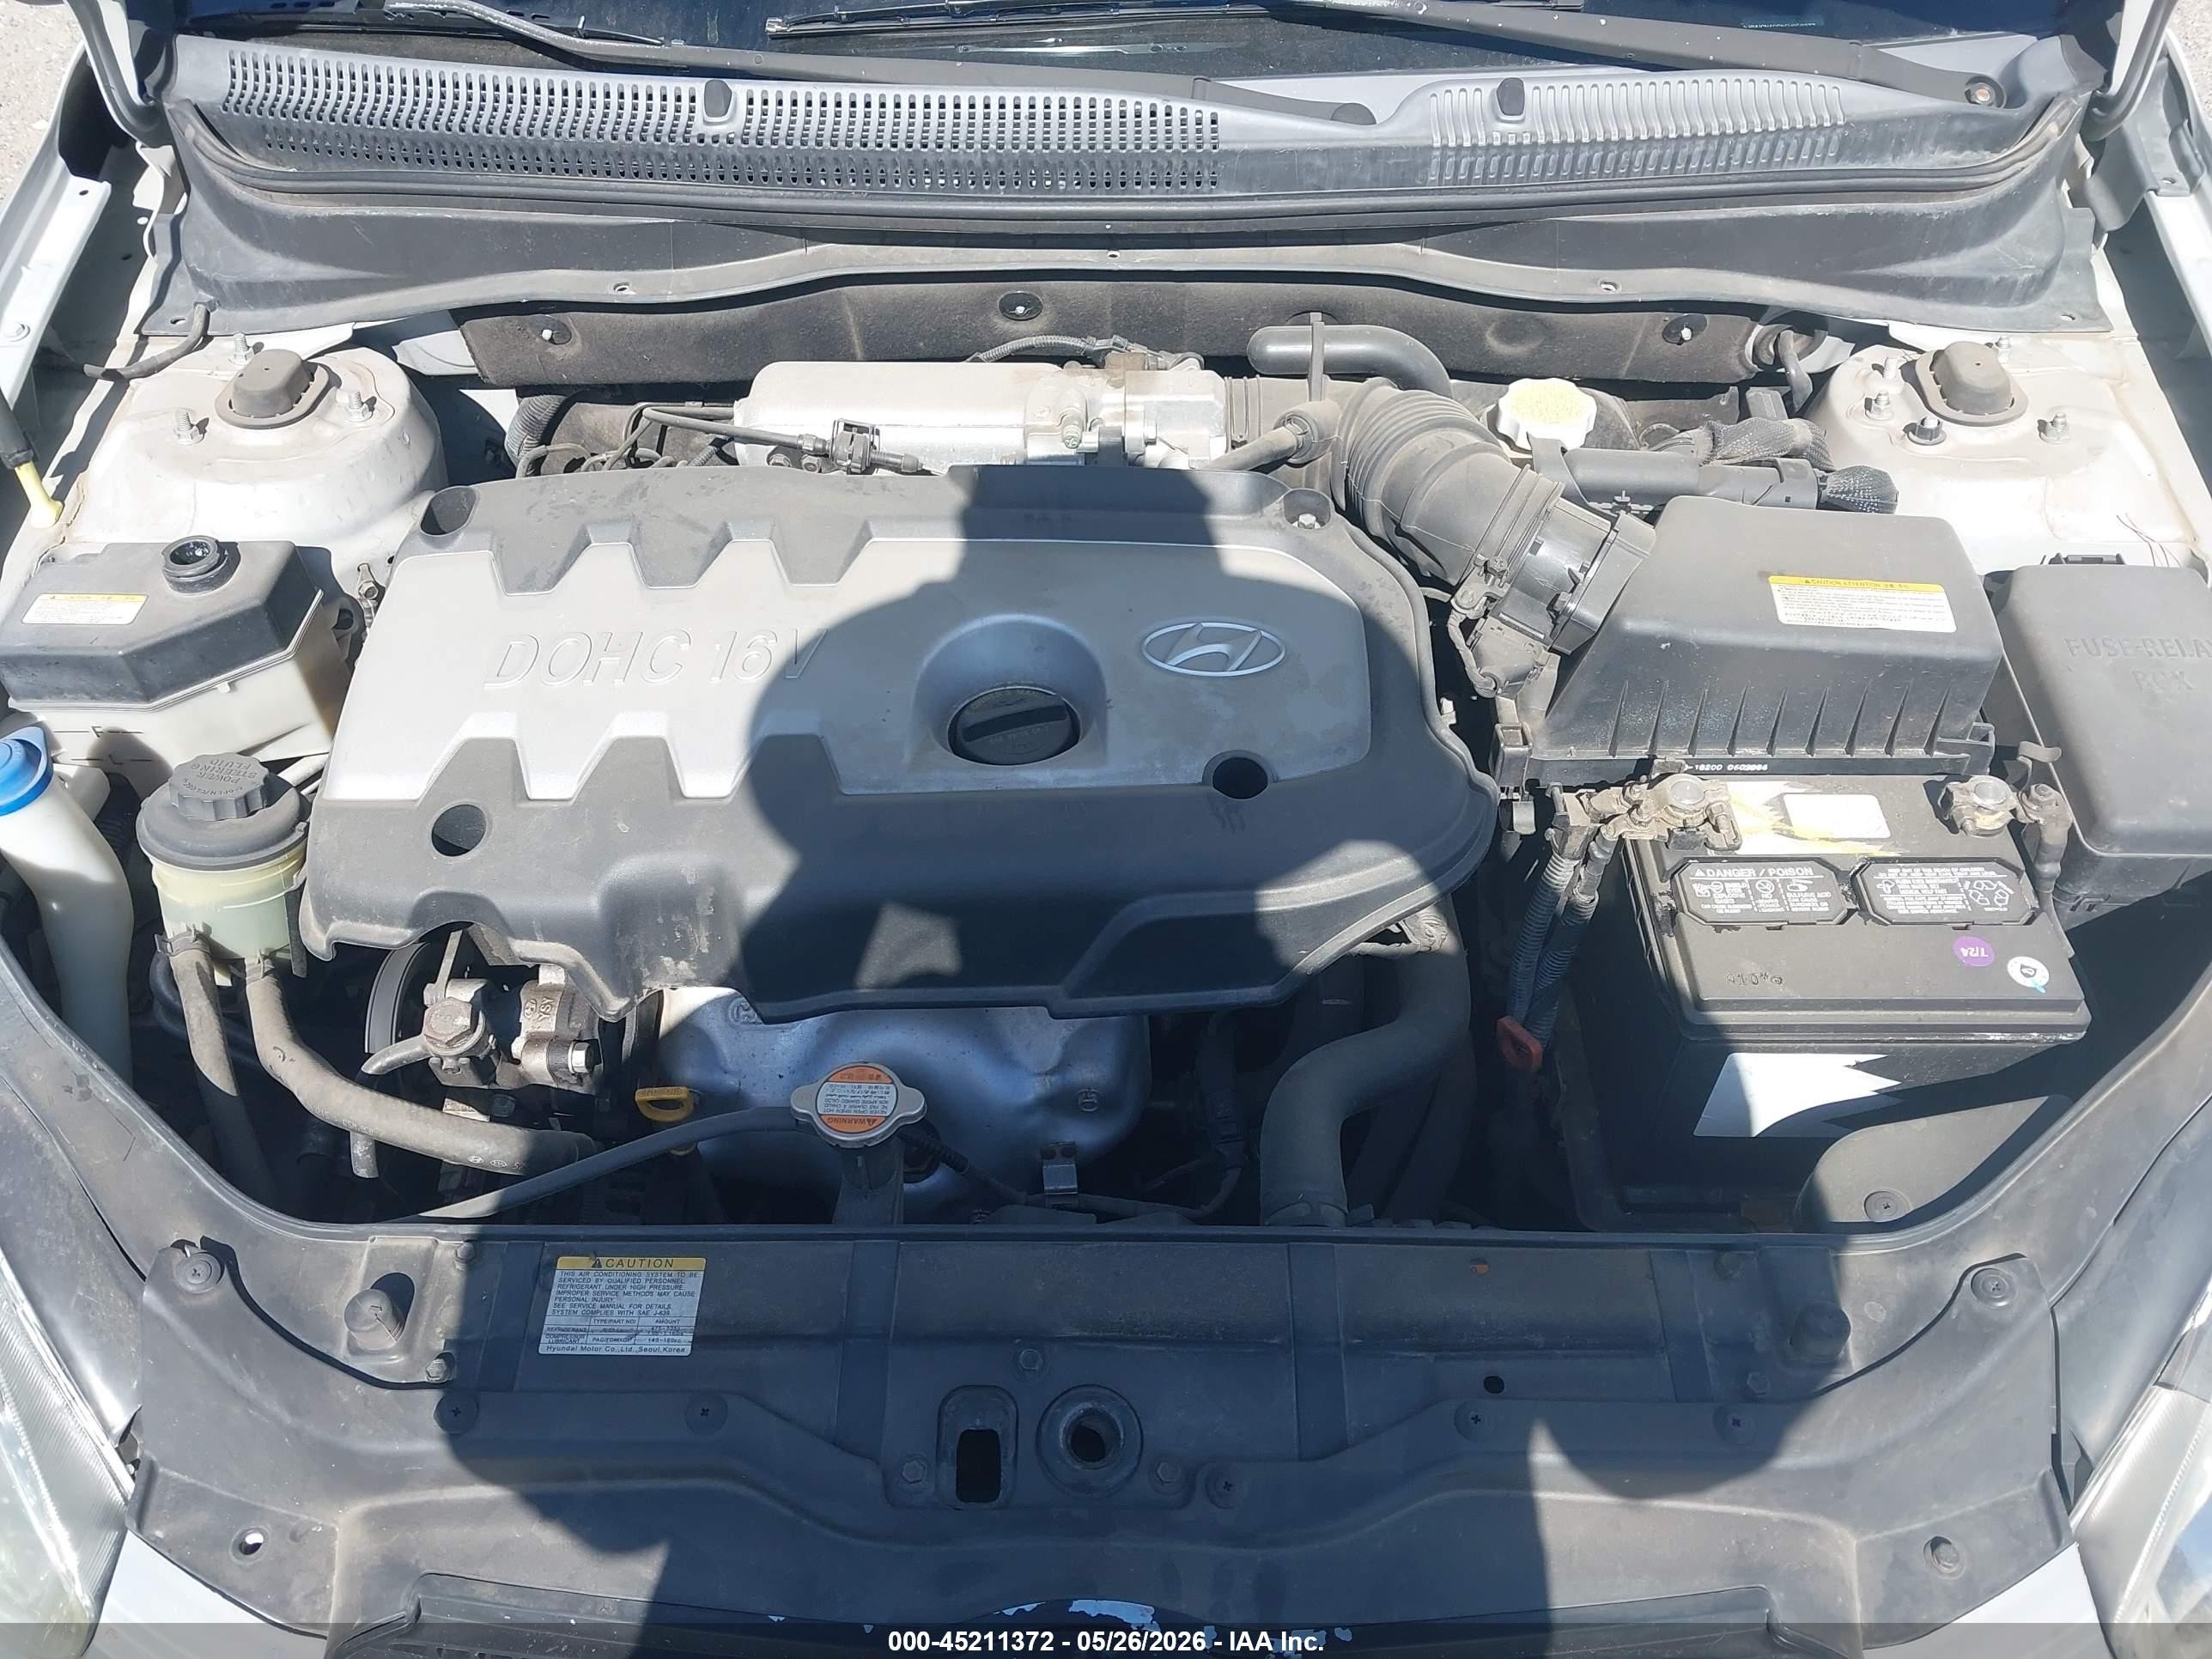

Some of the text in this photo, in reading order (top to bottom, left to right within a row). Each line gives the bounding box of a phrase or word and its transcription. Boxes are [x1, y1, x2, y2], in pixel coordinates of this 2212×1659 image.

[483, 628, 830, 689] DOHC 16V
[210, 758, 252, 770] FLUID
[191, 763, 258, 779] STEERING
[198, 771, 241, 784] POWER
[1706, 868, 1756, 877] DANGER
[1770, 866, 1814, 876] POISON
[605, 1259, 674, 1268] CAUTION
